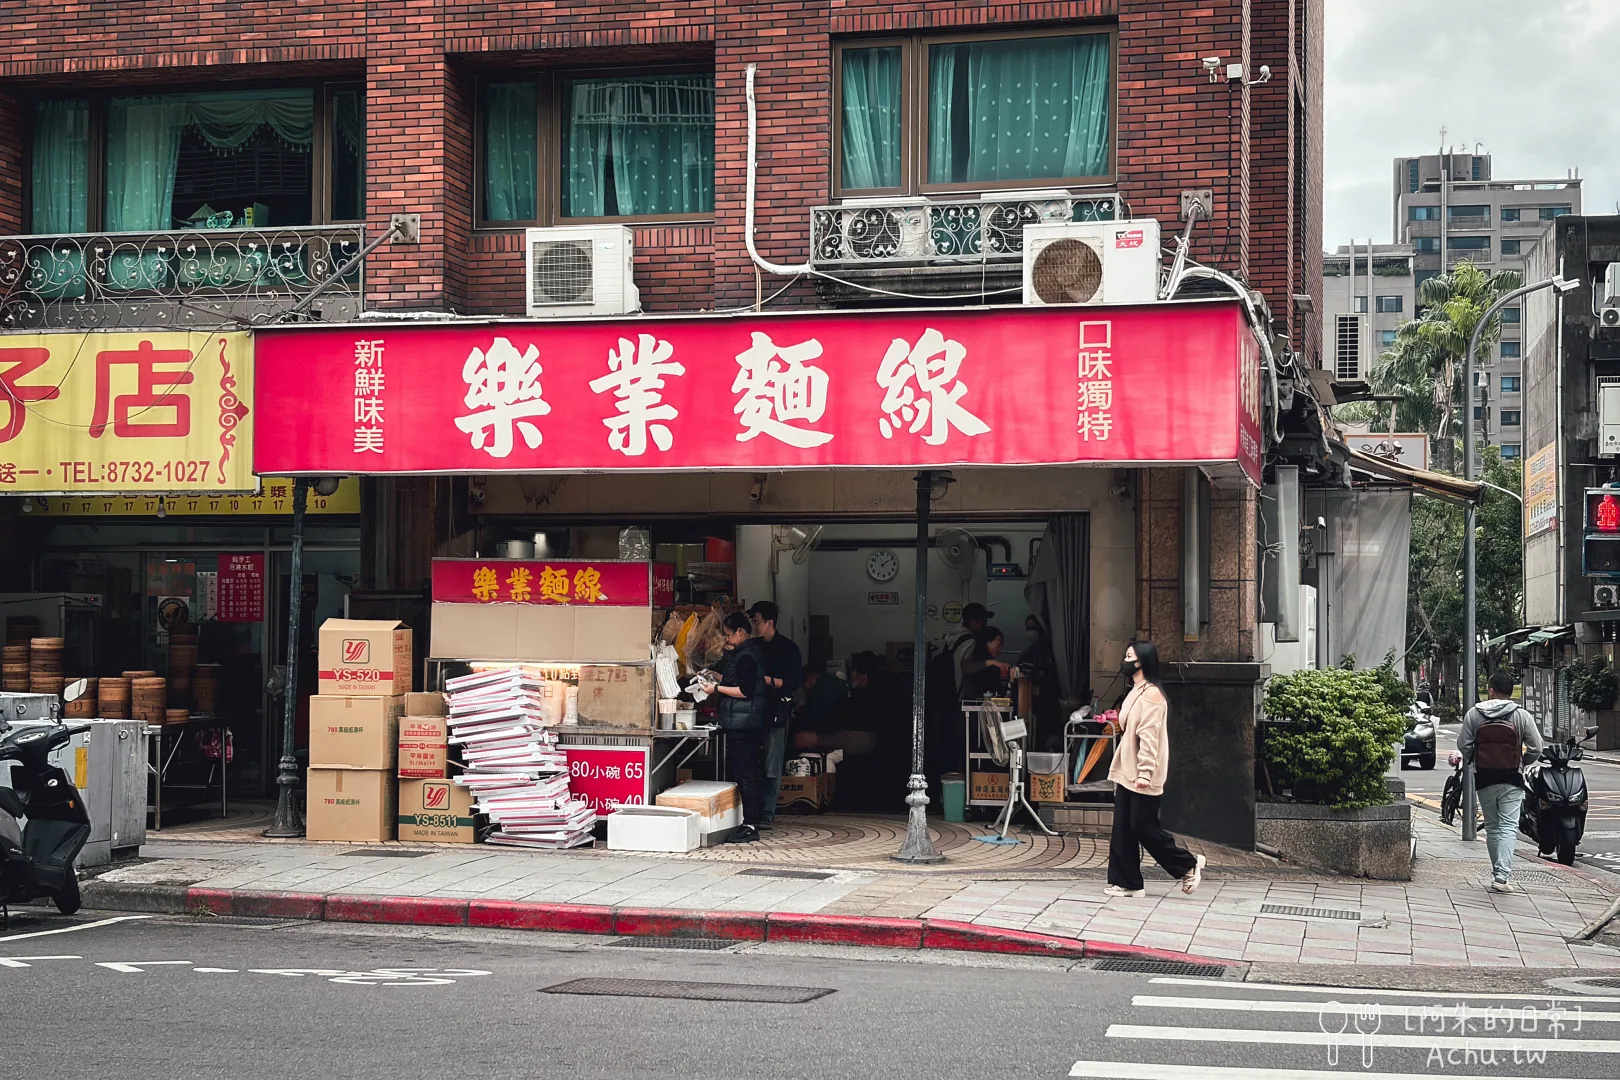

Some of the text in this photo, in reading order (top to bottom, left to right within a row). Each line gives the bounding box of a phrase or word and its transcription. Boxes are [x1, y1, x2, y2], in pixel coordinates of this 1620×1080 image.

[454, 328, 991, 457] 樂業麵線
[1077, 320, 1112, 441] 口味獨特
[354, 339, 385, 453] 新鮮味美
[62, 499, 326, 512] 17 17 17 17 17 17 17 17 10 17 17 10
[471, 565, 604, 603] 樂業麵線
[332, 668, 380, 682] YS-520
[625, 762, 643, 778] 65
[414, 814, 458, 828] YS-8511
